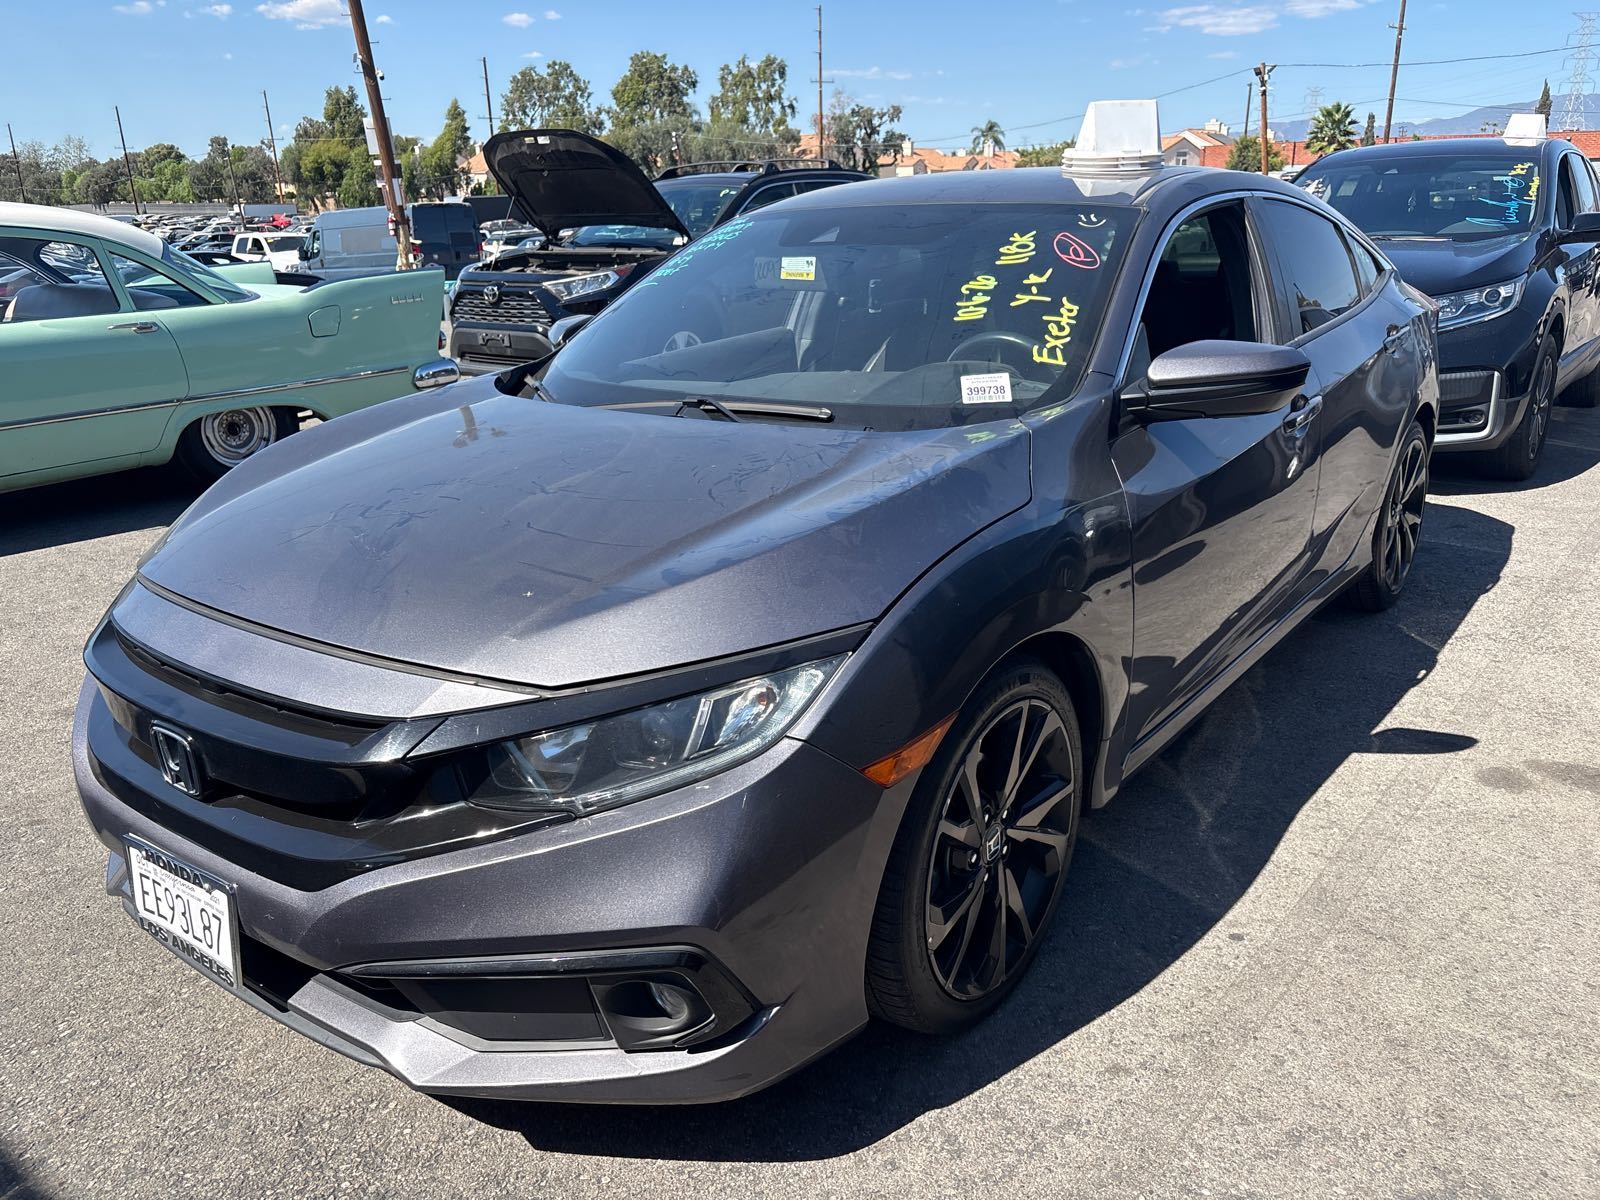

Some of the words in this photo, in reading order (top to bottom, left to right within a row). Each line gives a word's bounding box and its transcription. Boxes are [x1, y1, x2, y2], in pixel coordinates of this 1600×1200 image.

[1032, 296, 1080, 366] Exeter
[966, 385, 1006, 396] 399738
[143, 848, 204, 889] HONDA
[138, 872, 222, 956] EE93L87
[139, 916, 169, 943] LOS
[171, 931, 235, 988] ANGELES
